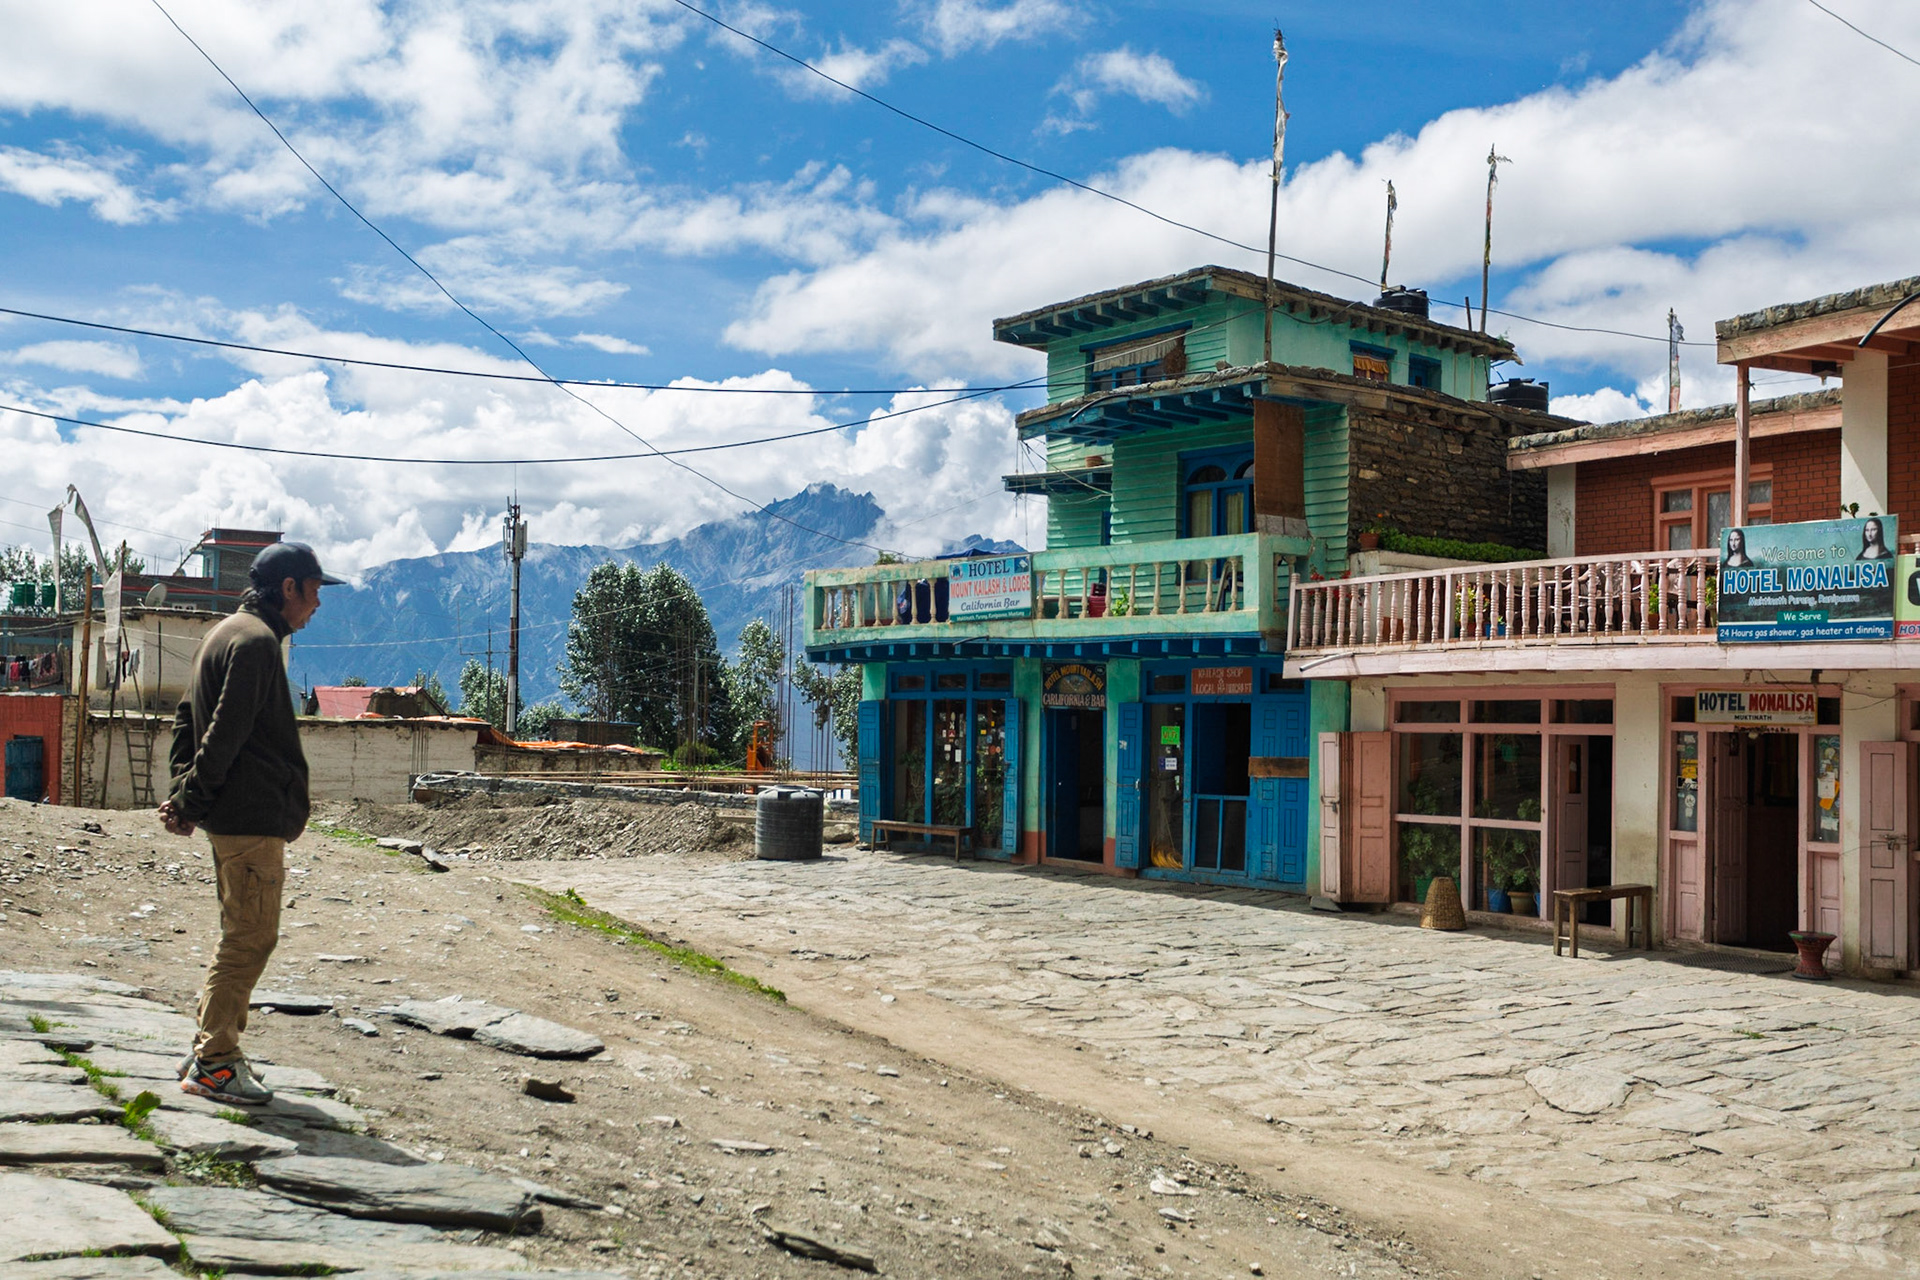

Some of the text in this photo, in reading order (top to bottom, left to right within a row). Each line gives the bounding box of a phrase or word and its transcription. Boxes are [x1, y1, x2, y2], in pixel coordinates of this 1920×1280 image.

[1761, 544, 1847, 562] Welcome to
[969, 560, 1010, 577] HOTEL
[1723, 568, 1782, 595] HOTEL
[1786, 561, 1889, 592] MONALISA
[950, 581, 972, 598] MOUNT
[974, 578, 1000, 595] KAILASH
[1009, 575, 1031, 592] LODGE
[961, 597, 1020, 611] California Bar
[1783, 612, 1821, 621] We Serve
[1720, 629, 1729, 637] 24
[1731, 629, 1753, 637] Hours
[1755, 629, 1767, 639] gas
[1800, 628, 1813, 638] gas
[1815, 626, 1843, 635] heater
[1844, 626, 1853, 634] at
[1226, 667, 1244, 678] SHOP
[1195, 683, 1216, 694] LOCAL
[1091, 694, 1105, 707] BAR
[1699, 693, 1815, 711] HOTEL MONALISA
